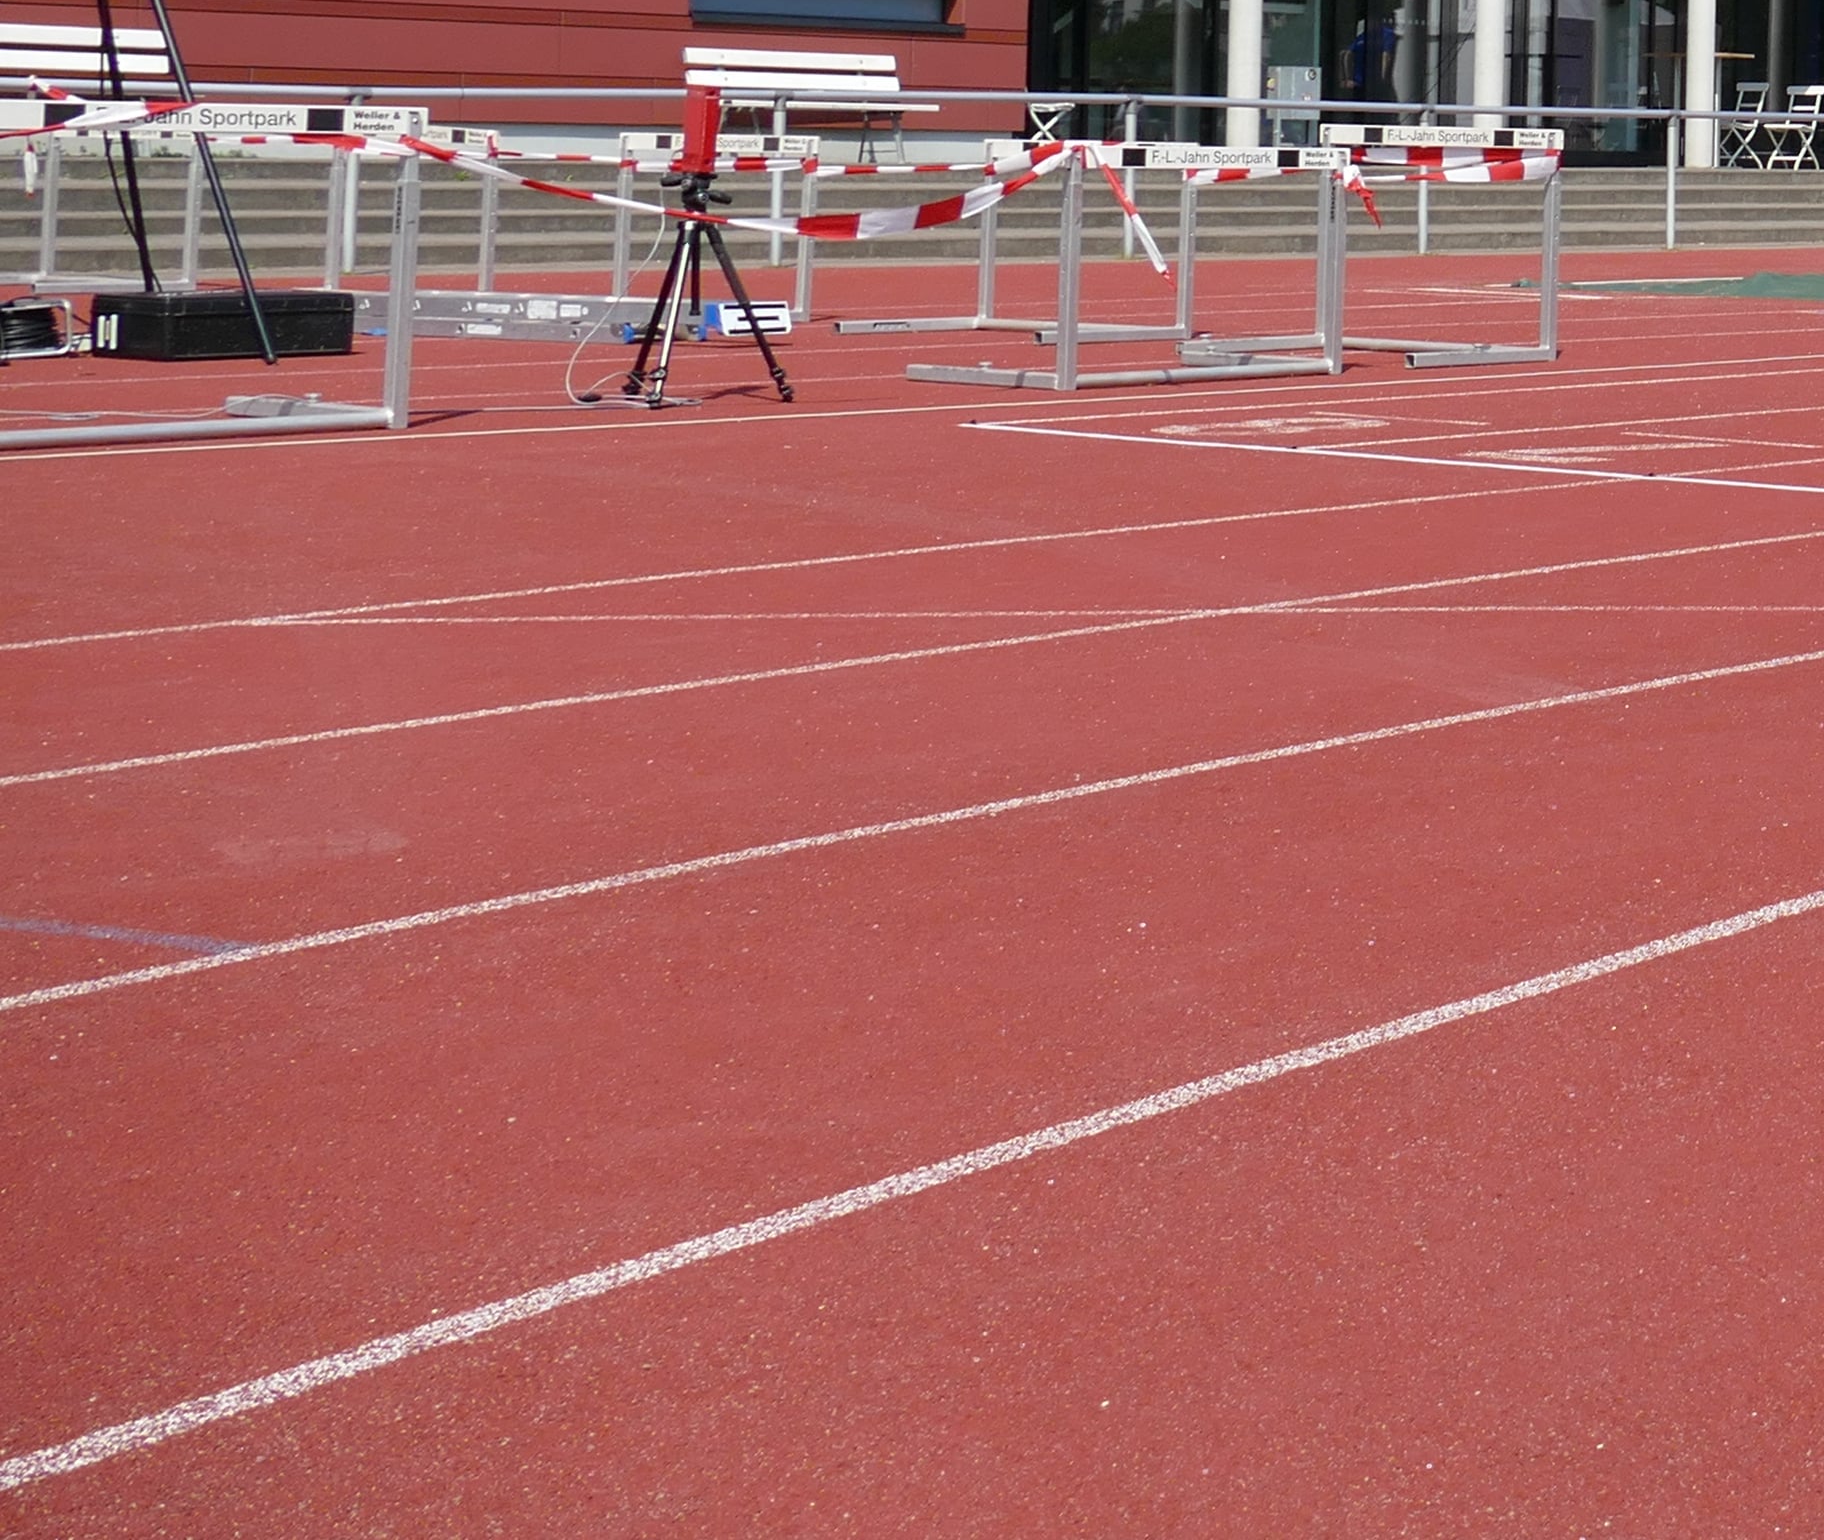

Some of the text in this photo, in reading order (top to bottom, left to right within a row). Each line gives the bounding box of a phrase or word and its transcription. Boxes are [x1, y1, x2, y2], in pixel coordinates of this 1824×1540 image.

[199, 109, 297, 129] Sportpark
[353, 110, 401, 120] Weller &
[353, 122, 395, 132] Herden
[1387, 128, 1489, 144] F.-L.-Jahn Sportpark
[1151, 149, 1272, 165] F.-L.-Jahn Sportpark
